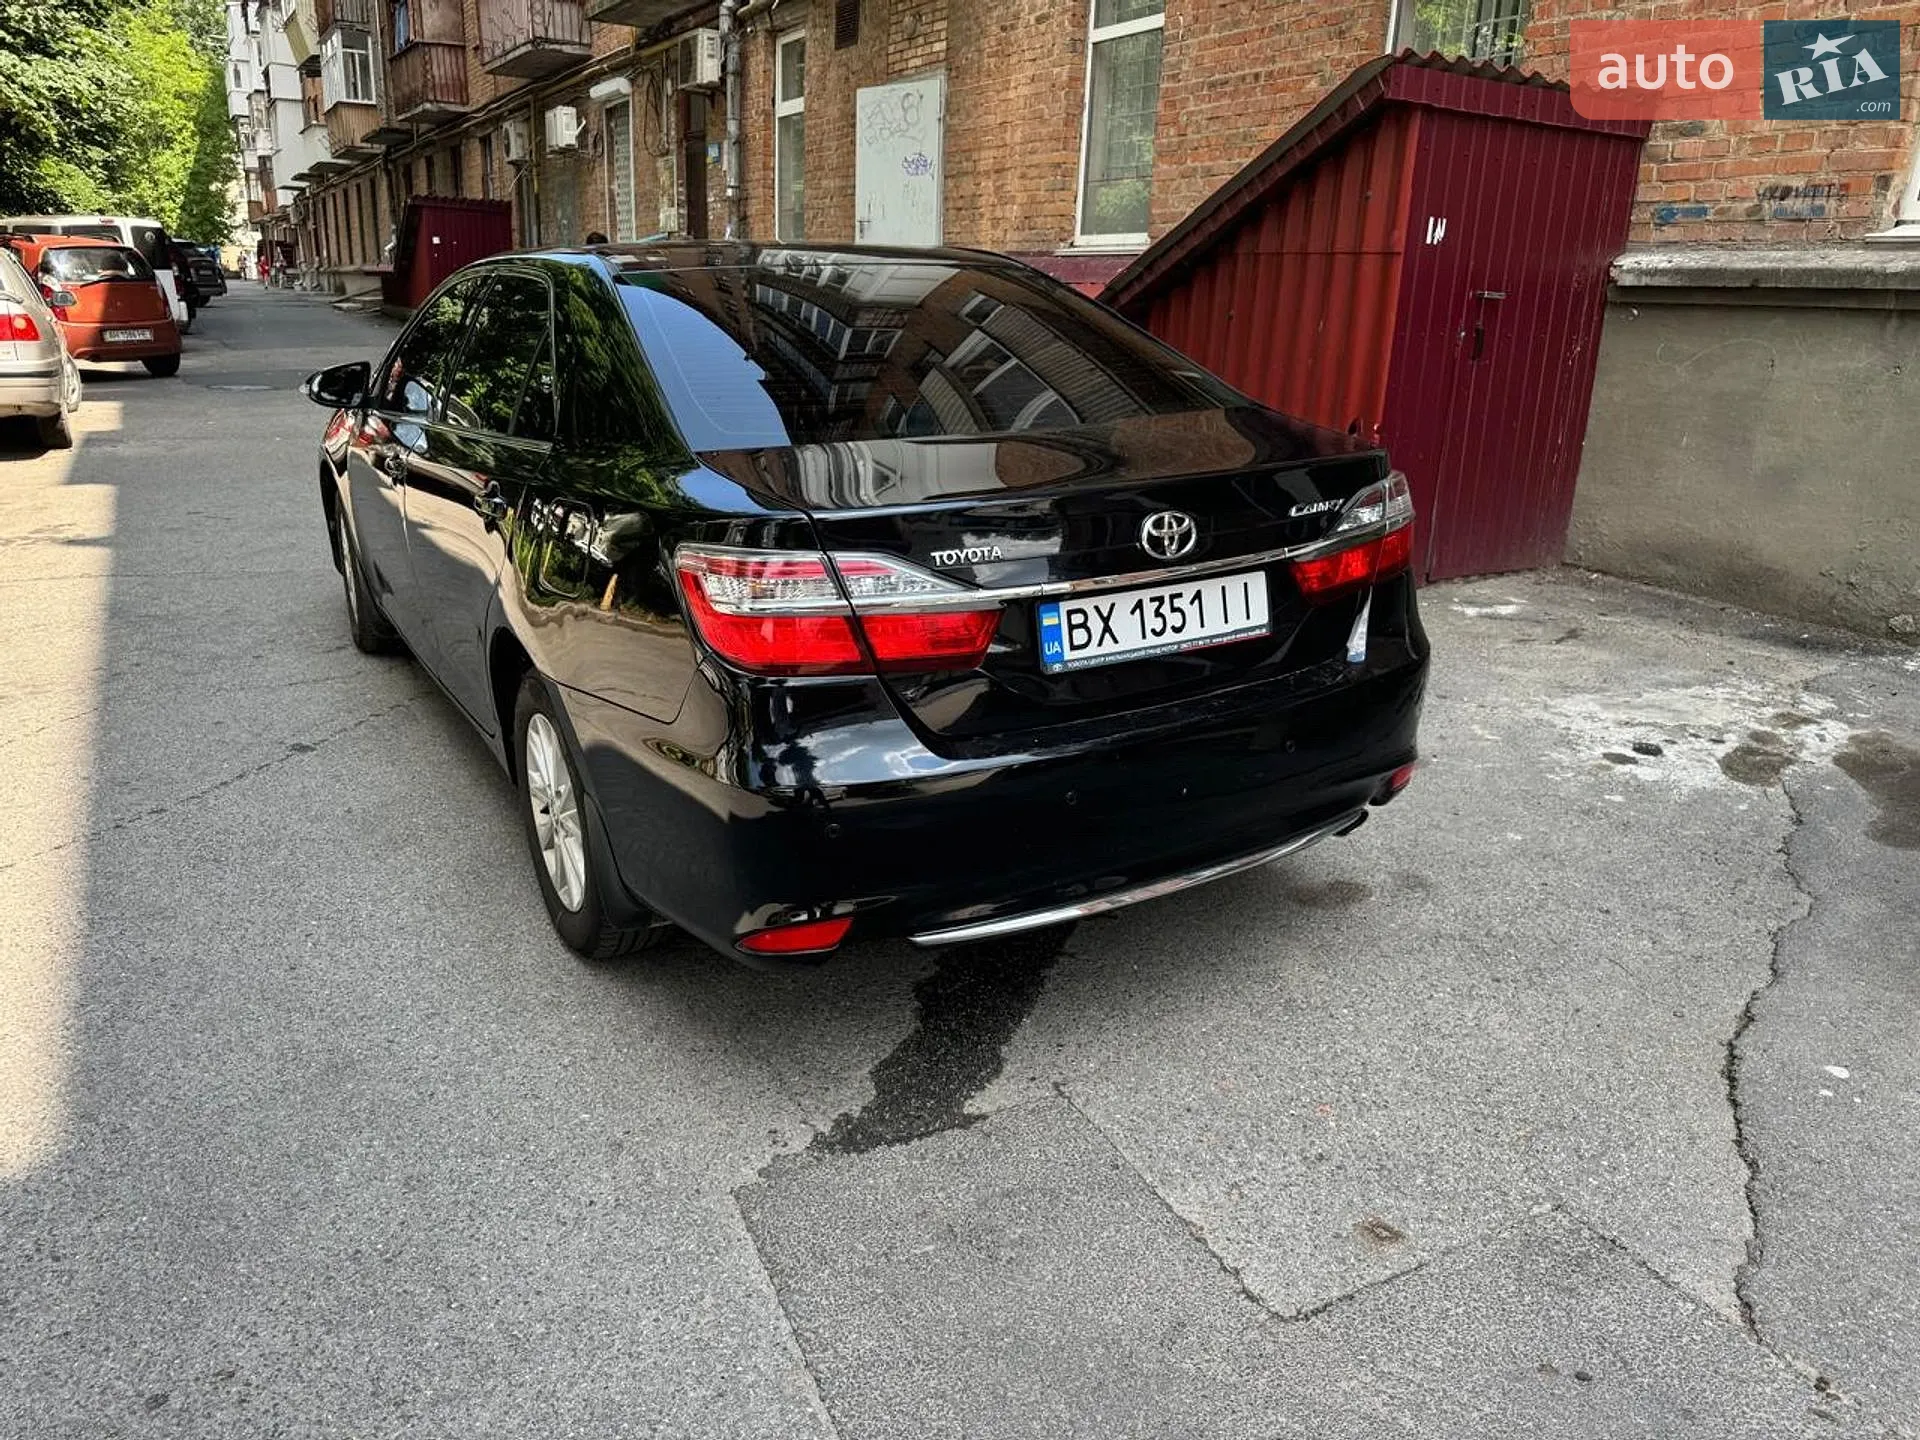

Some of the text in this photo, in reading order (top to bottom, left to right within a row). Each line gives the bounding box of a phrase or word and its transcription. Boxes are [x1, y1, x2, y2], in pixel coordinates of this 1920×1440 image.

[930, 546, 1003, 566] TOYOTA
[1066, 602, 1119, 652] BX
[1130, 589, 1205, 640] 1351
[1044, 642, 1062, 655] UA
